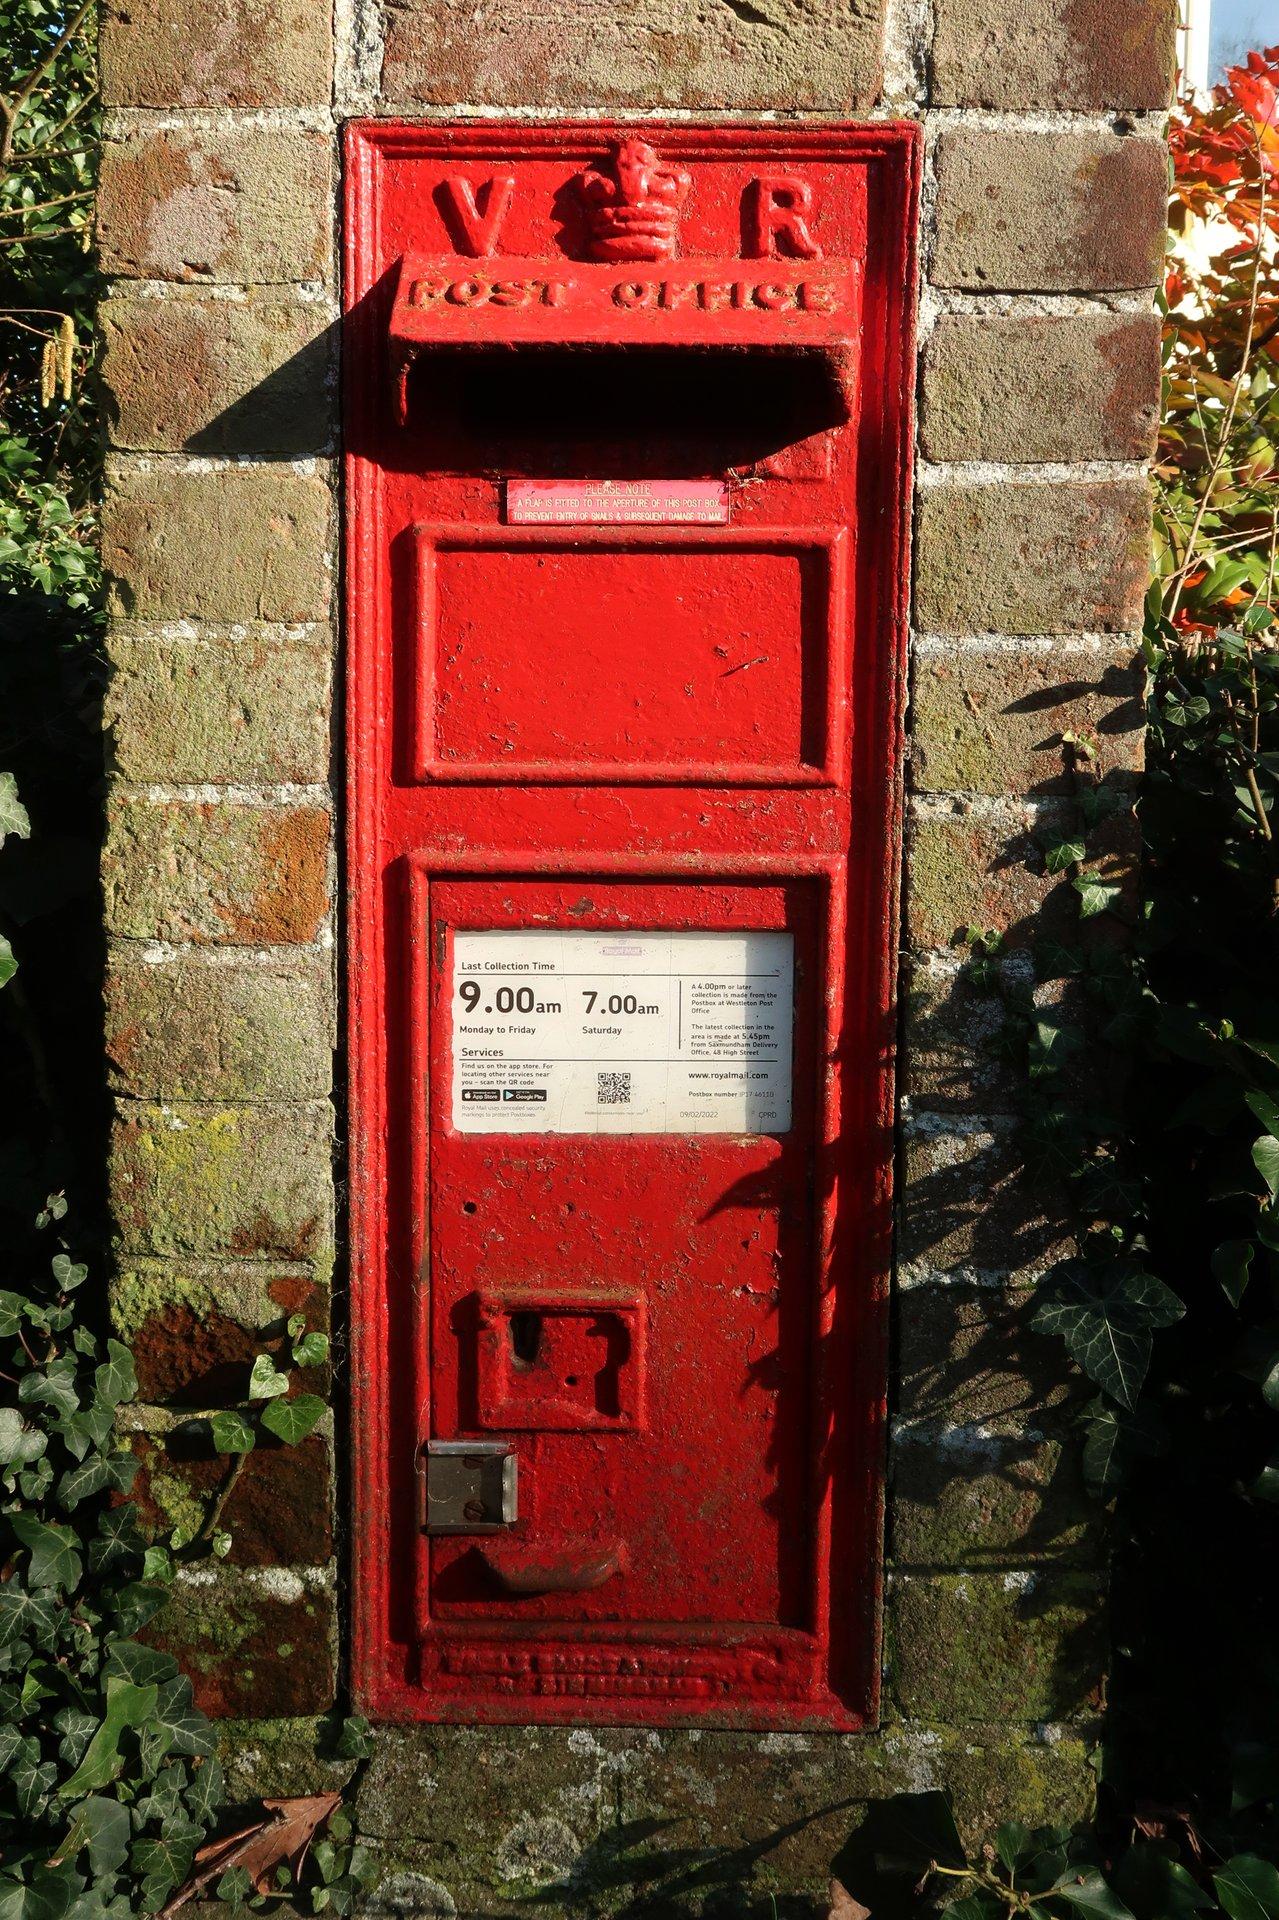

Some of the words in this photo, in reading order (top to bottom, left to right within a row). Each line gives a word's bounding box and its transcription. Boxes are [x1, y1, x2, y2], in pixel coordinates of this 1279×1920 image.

[445, 176, 515, 258] V
[755, 176, 823, 258] R
[409, 276, 575, 308] POST
[612, 279, 836, 313] OFFICE
[585, 484, 621, 495] PLEASE
[625, 484, 652, 495] NOTE
[518, 499, 523, 507] A
[525, 499, 542, 507] FLAP
[546, 499, 553, 507] IS
[555, 499, 580, 507] FITTED
[584, 499, 593, 507] TO
[597, 499, 609, 507] THE
[613, 499, 648, 507] APERTURE
[652, 499, 661, 507] OF
[665, 499, 680, 507] THIS
[683, 499, 702, 507] POST
[462, 962, 482, 970] Last
[485, 962, 529, 970] Collection
[532, 962, 556, 970] Time
[698, 983, 726, 991] 4.00pm
[459, 981, 562, 1013] 9.00am
[582, 991, 660, 1014] 7.00am
[460, 1026, 494, 1035] Monday
[509, 1026, 536, 1035] Friday
[582, 1026, 622, 1036] Saturday
[742, 1033, 771, 1041] 5.45pm
[462, 1048, 504, 1057] Services
[689, 1072, 769, 1080] www.royalmail.com
